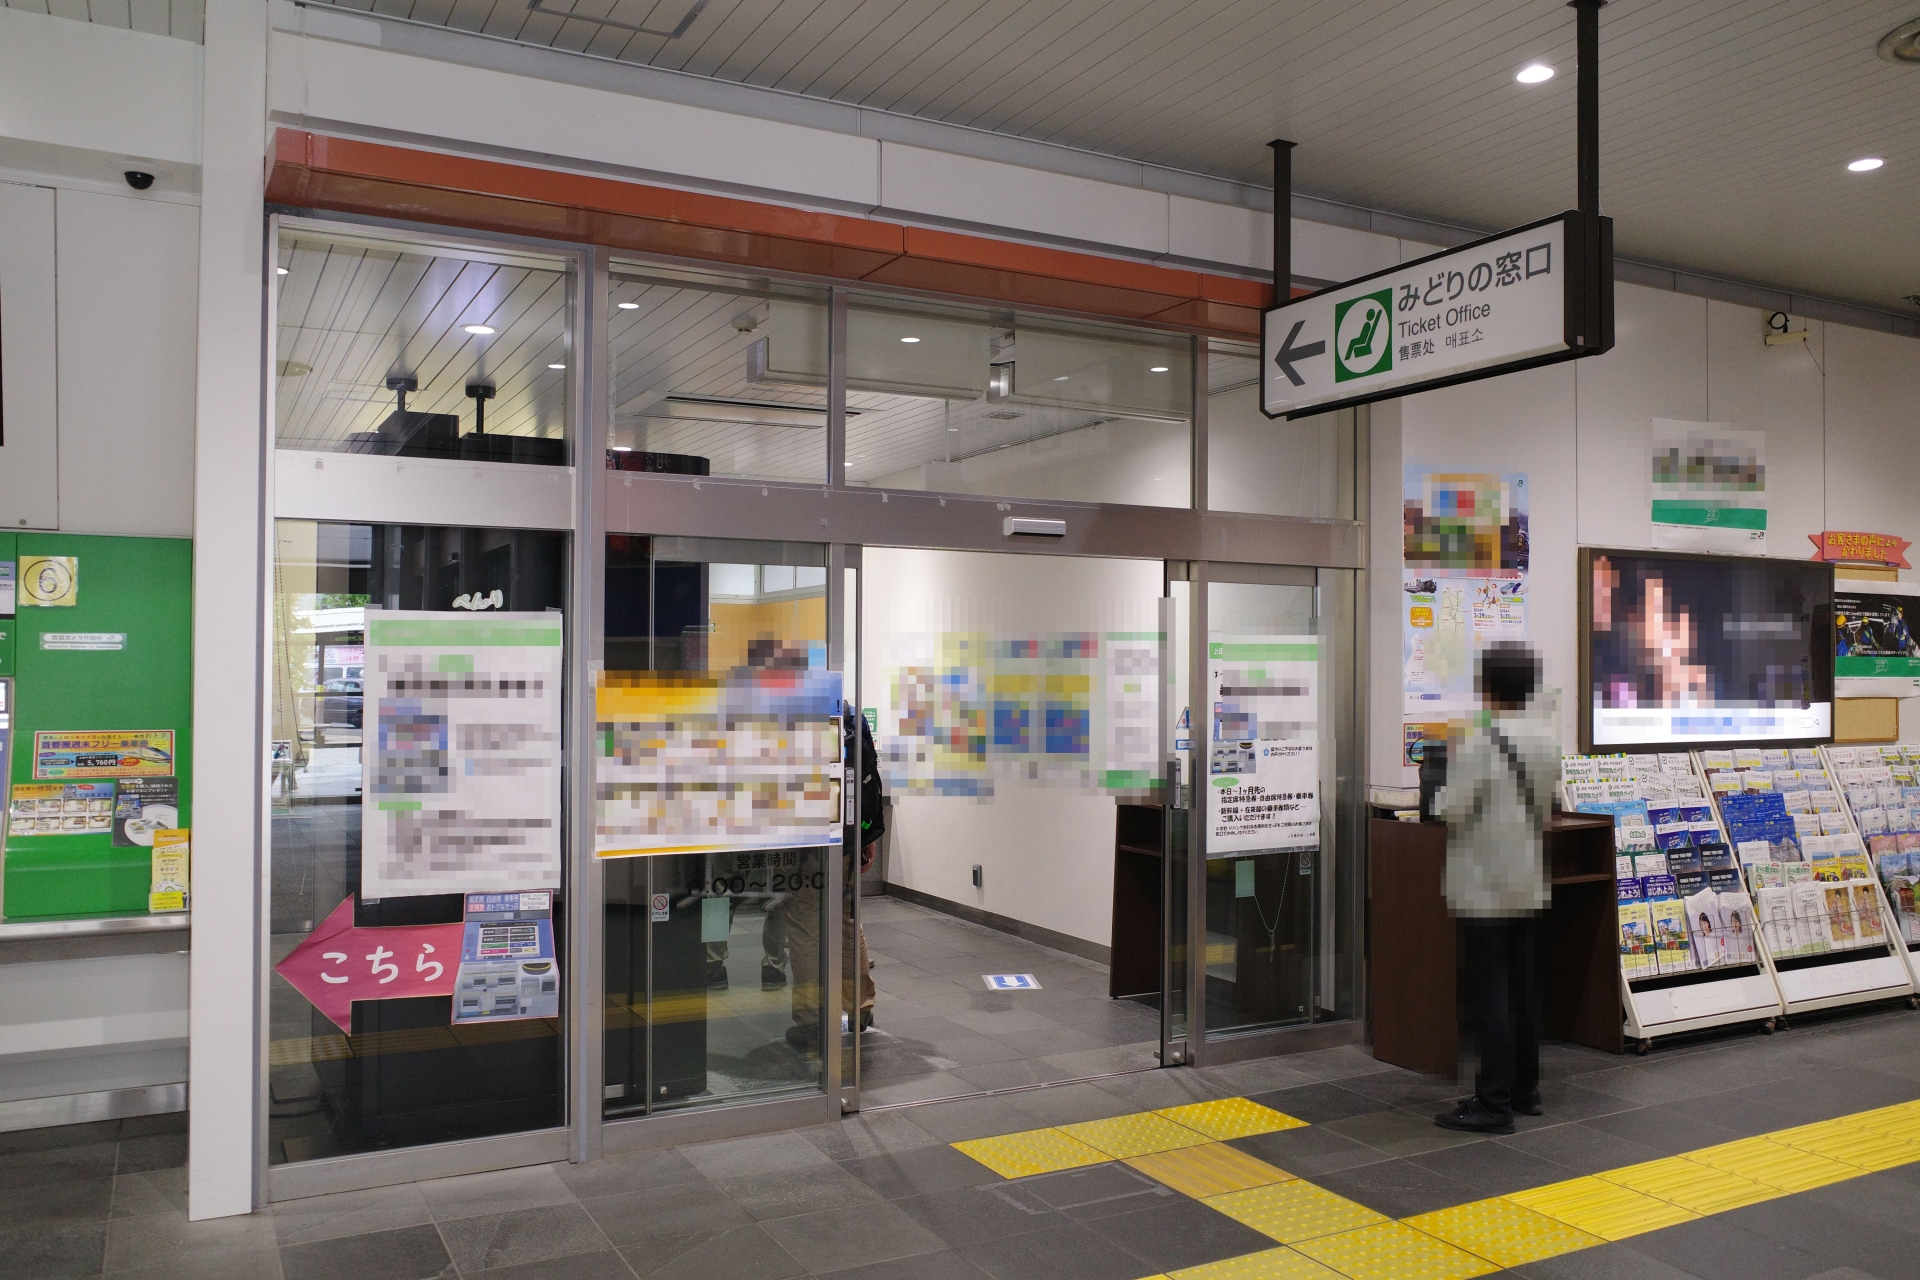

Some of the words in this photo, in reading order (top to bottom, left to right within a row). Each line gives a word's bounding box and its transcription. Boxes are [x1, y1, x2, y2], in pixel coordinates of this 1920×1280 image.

[1398, 242, 1552, 313] みどりの窓口
[1398, 313, 1442, 339] Ticket
[1445, 302, 1491, 327] Office
[1445, 327, 1484, 350] 매표소
[1398, 340, 1436, 363] 售票处
[1827, 533, 1898, 548] お客さまの声により
[1841, 547, 1888, 561] かわりました
[41, 740, 149, 749] 首都圏週末フリー乗車券
[736, 851, 797, 871] 営業時間
[320, 943, 444, 984] こちら
